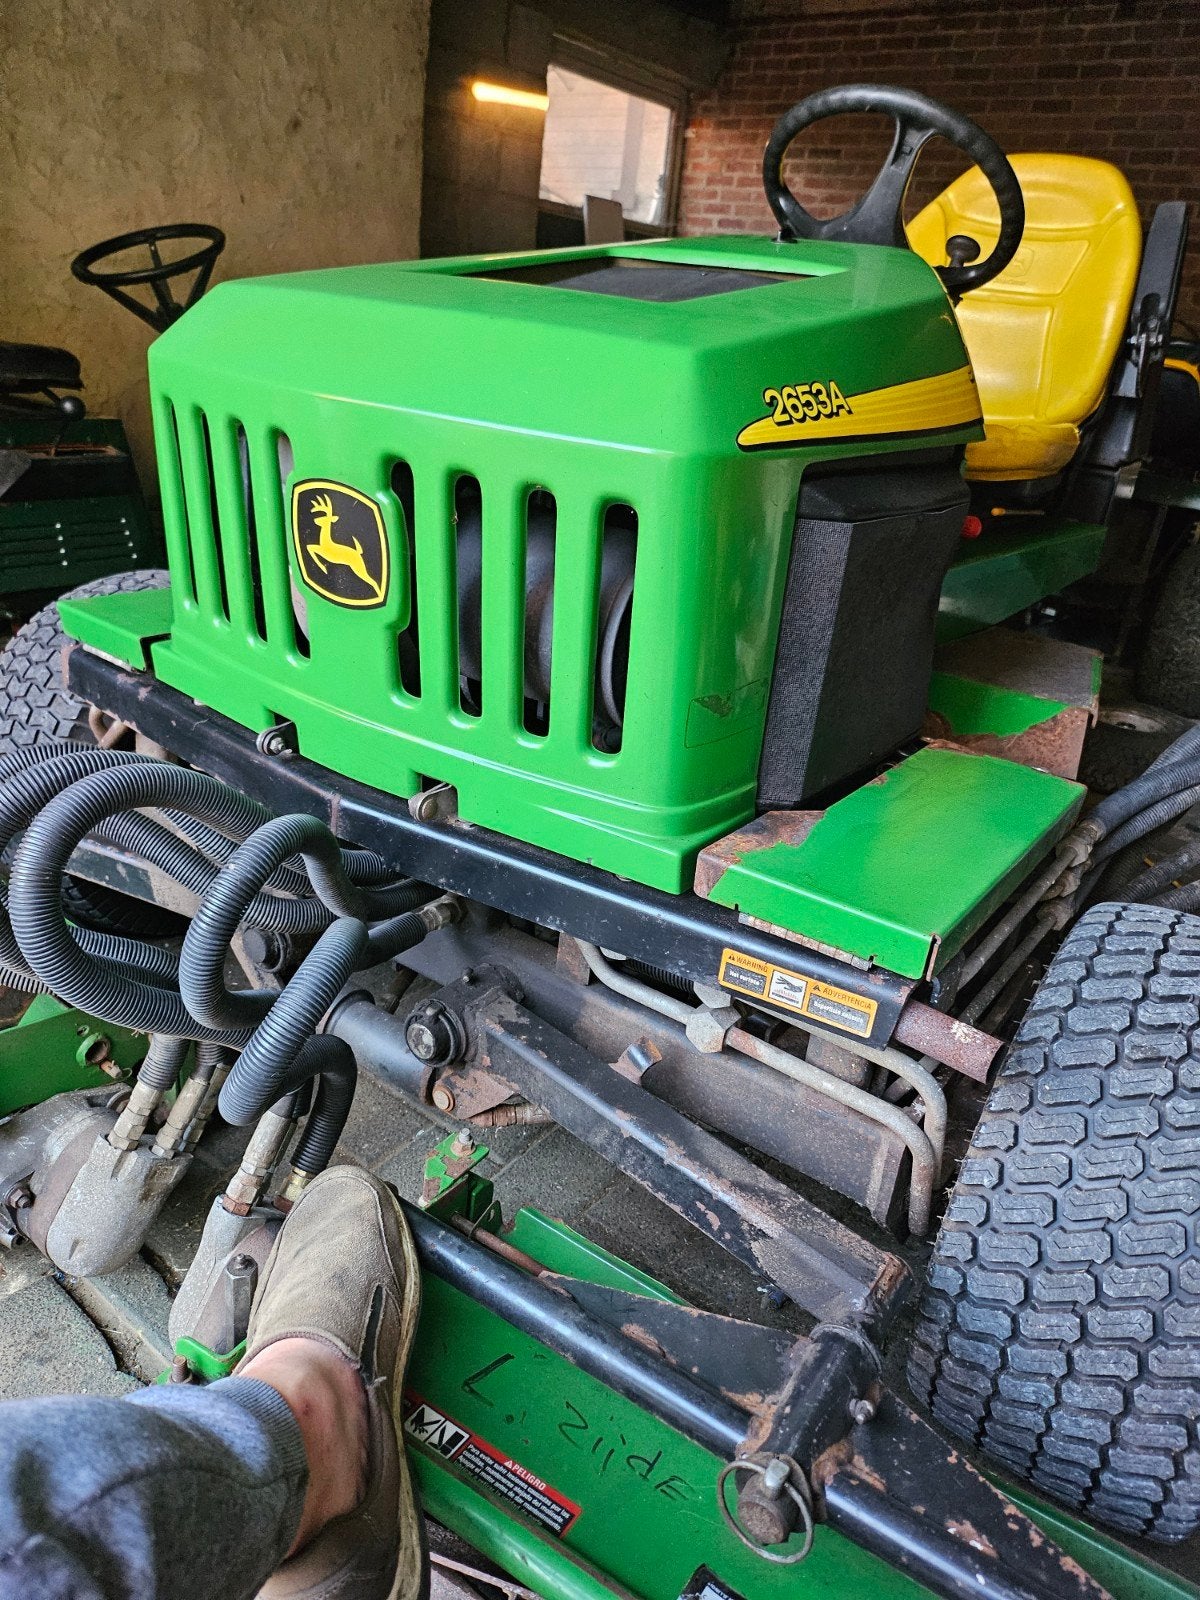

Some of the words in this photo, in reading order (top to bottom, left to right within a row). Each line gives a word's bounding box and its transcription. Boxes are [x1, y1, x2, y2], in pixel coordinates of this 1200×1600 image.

[763, 381, 853, 426] 2653A
[735, 956, 769, 973] WARNING
[821, 987, 872, 1010] ADVERTENCIA
[513, 1464, 547, 1491] PELIGRO
